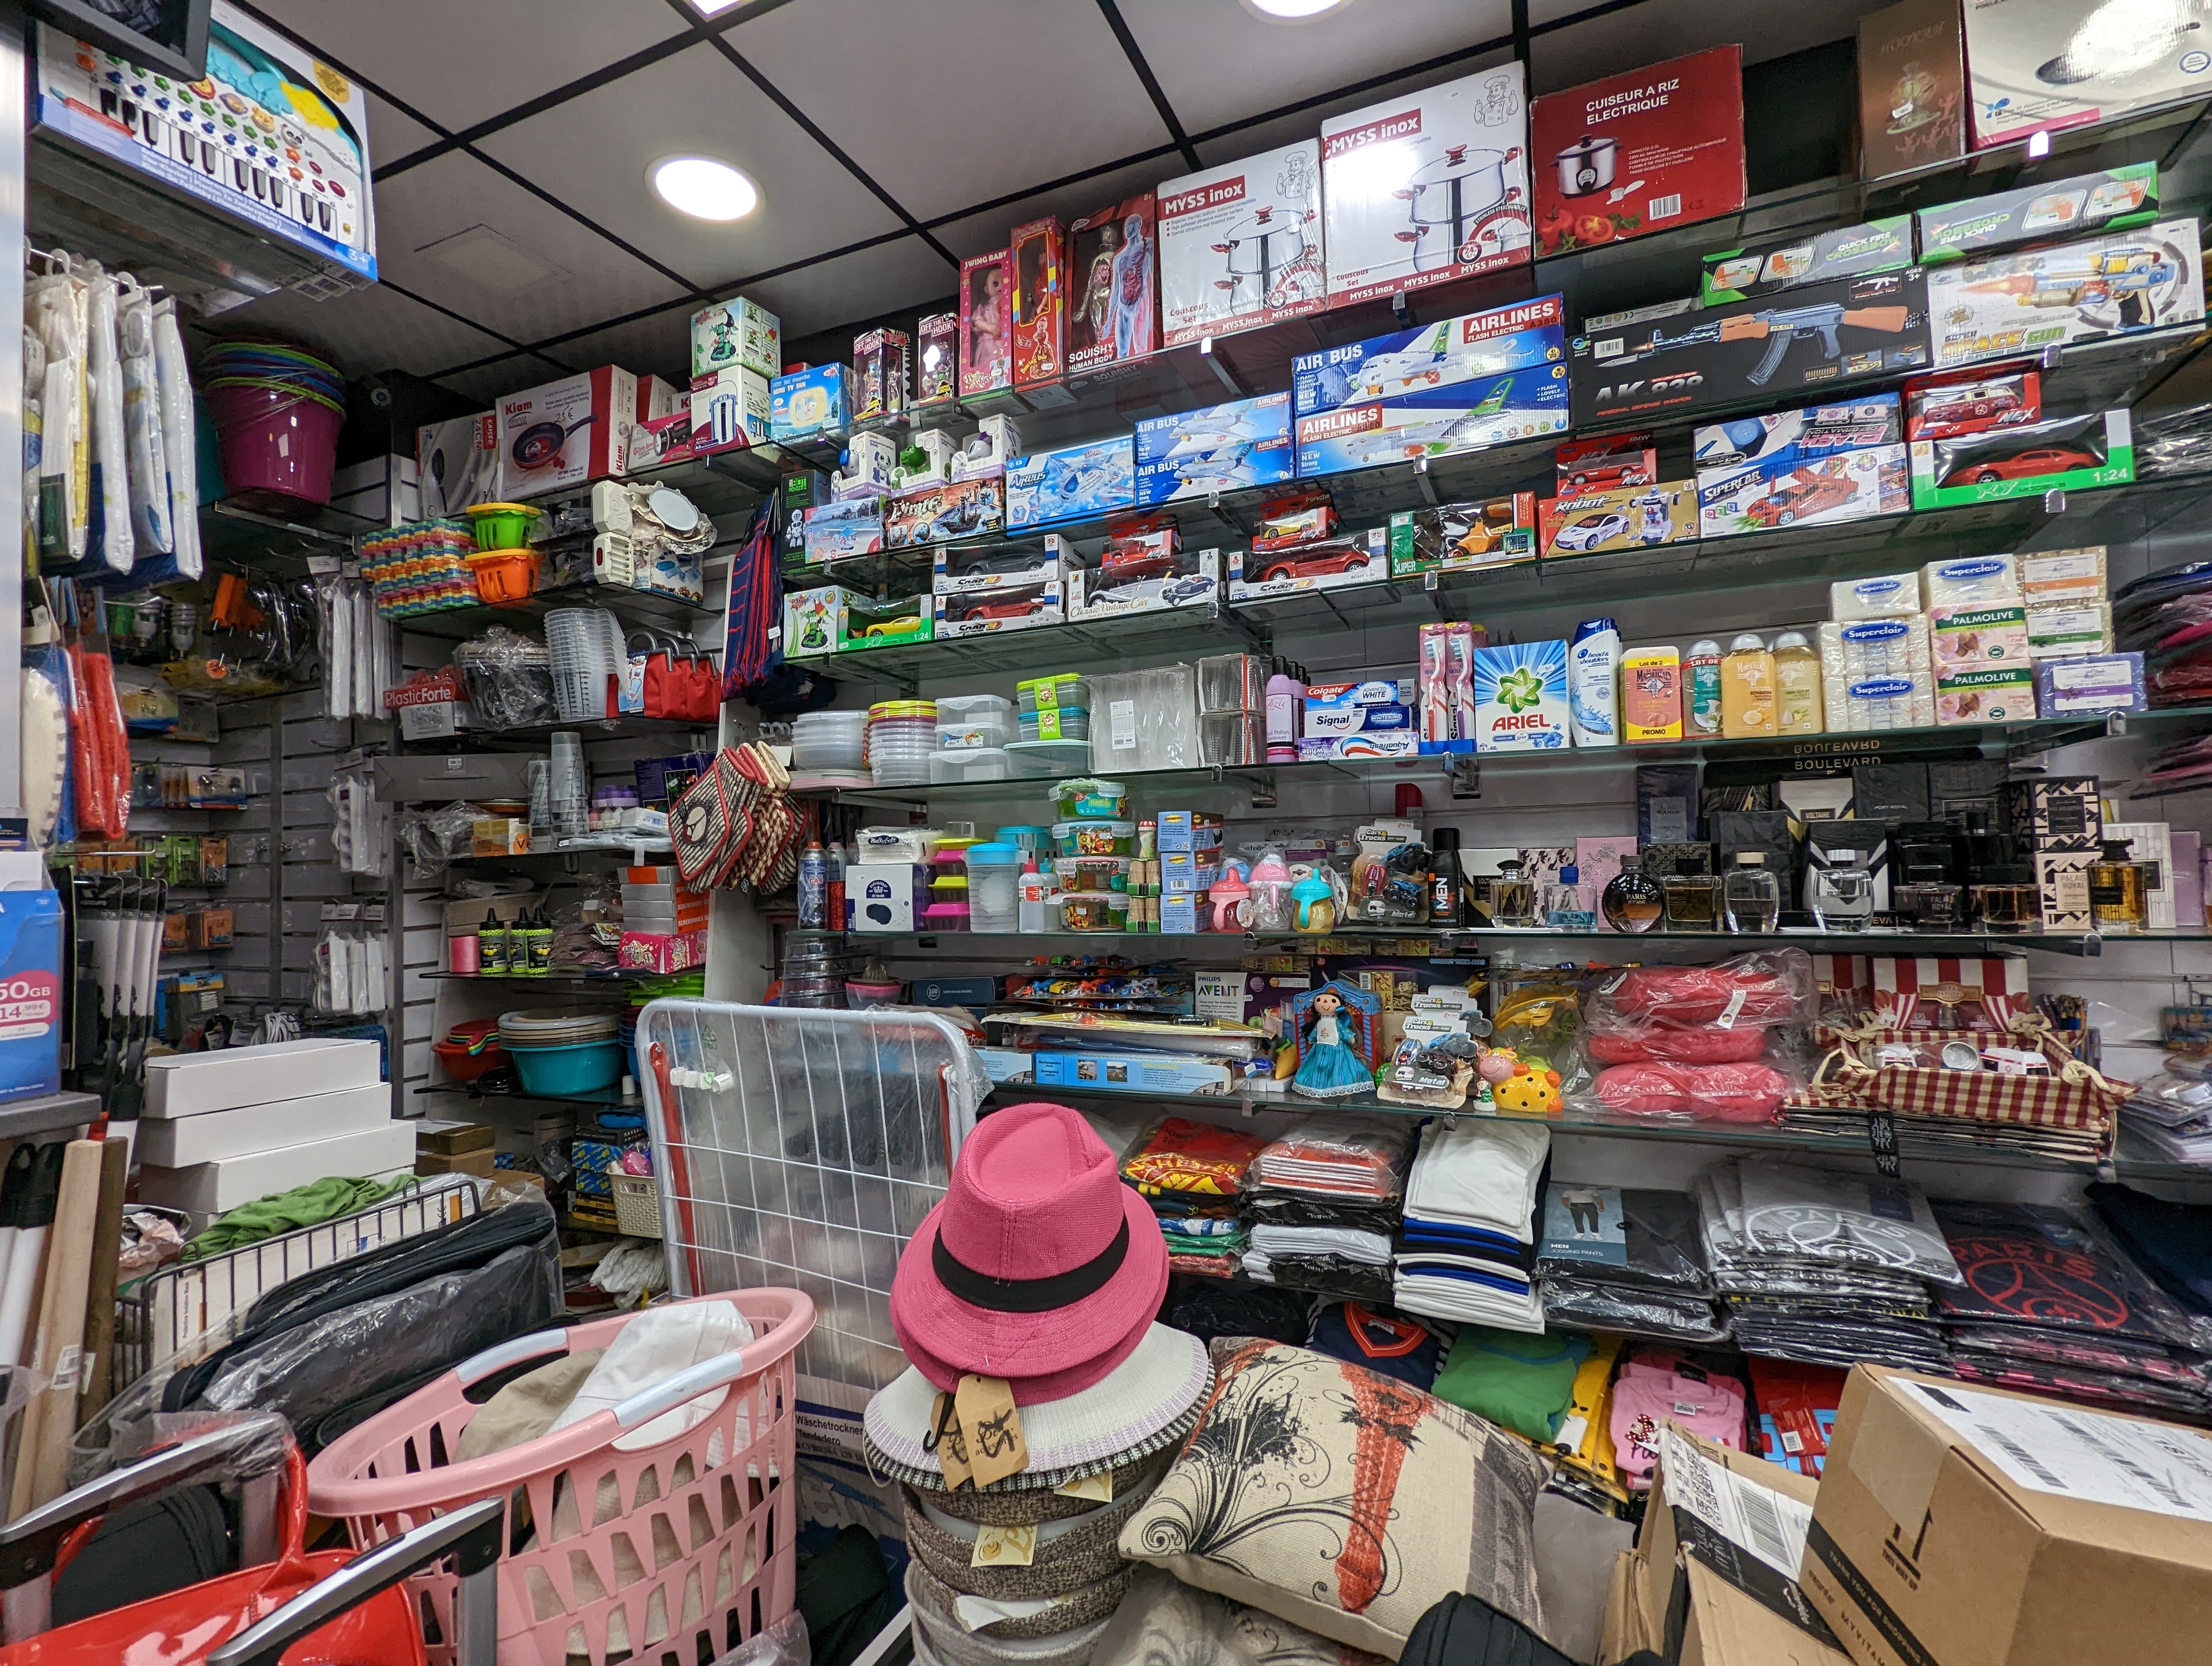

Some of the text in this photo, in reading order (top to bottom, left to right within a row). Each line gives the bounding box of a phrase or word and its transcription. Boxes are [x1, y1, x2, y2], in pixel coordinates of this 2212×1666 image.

[1586, 79, 1680, 112] CUISEUR A RIZ
[1587, 95, 1669, 125] ELECTRIQUE
[1332, 117, 1419, 153] MYSS inox
[1165, 183, 1243, 215] MYSS inox
[1837, 230, 1892, 252] QUICK FIRE
[1939, 223, 1997, 245] QUICK FIRE
[1825, 234, 1900, 261] CROSSBOW
[349, 248, 368, 264] 3+
[964, 251, 1007, 268] SWING BABY
[1461, 257, 1509, 274] MYSS inox
[1905, 267, 1922, 275] AGES
[1336, 268, 1369, 281] Couscous
[1404, 271, 1451, 288] MYSS inox
[1908, 273, 1921, 282] 3+
[1347, 279, 1359, 287] Set
[1349, 284, 1394, 300] MYSS inox
[1170, 303, 1209, 317] Couscous
[1271, 304, 1314, 319] MYSS inox
[933, 318, 942, 326] THE
[1182, 316, 1197, 325] Set
[1223, 316, 1263, 331] MYSS inox
[1468, 302, 1555, 334] AIRLINES
[921, 322, 933, 333] OFF
[933, 323, 953, 335] HOOK
[1197, 328, 1214, 336] inox
[1468, 324, 1525, 342] FLASH ELECTRIC
[2027, 326, 2067, 345] GUN
[854, 341, 865, 352] OFF
[865, 339, 882, 354] HOOK
[1069, 342, 1114, 364] SQUISHY
[1069, 354, 1114, 372] HUMAN BODY
[1296, 343, 1363, 372] AIR BUS
[787, 385, 795, 393] TV
[1298, 391, 1317, 400] NEW
[1541, 388, 1561, 396] LOVELY
[1257, 394, 1288, 407] AIRLINES
[1541, 392, 1566, 402] ELECTRIC
[505, 401, 532, 415] Kiam
[1597, 395, 1692, 416] PERSONAL DEFENSE WEAPON
[554, 405, 574, 424] 25€
[1303, 408, 1379, 435] AIRLINES
[1997, 406, 2037, 424] NEX
[1137, 416, 1179, 433] AIR BUS
[1257, 436, 1289, 448] AIRLINES
[1303, 428, 1353, 444] FLASH ELECTRIC
[1629, 434, 1651, 443] BMW
[1301, 452, 1321, 462] NEW
[1138, 459, 1179, 477] AIR BUS
[2093, 467, 2128, 482] 1:24
[1622, 471, 1652, 485] NEX
[1705, 470, 1762, 502] SUPERCAR
[1305, 494, 1330, 503] Porsche
[1552, 494, 1611, 516] Robot
[1300, 527, 1322, 539] NEX
[1146, 547, 1167, 559] NEX
[1394, 558, 1417, 575] SUPER
[1944, 563, 2001, 577] Superclair
[1858, 581, 1898, 593] Superclair
[1070, 597, 1149, 618] Classic Vintage Car
[1953, 610, 2015, 625] PALMOLIVE
[1849, 626, 1904, 639] Superclair
[1966, 623, 2002, 631] NATURALS
[913, 632, 929, 642] 1:24
[1579, 657, 1610, 665] shoulders
[1954, 672, 2017, 685] PALMOLIVE
[384, 686, 452, 704] PlasticForte
[1308, 685, 1345, 697] Colgate
[1362, 685, 1387, 694] ADVANCED
[1362, 690, 1387, 700] WHITE
[1855, 683, 1908, 695] Superclair
[1316, 715, 1350, 727] Signal
[1371, 714, 1403, 722] WHITENING
[1491, 714, 1551, 732] ARIEL
[1369, 741, 1410, 751] Aquafresh
[1795, 756, 1881, 771] BOULEVARD
[1358, 833, 1386, 842] Trucks
[2060, 874, 2087, 882] PALAIS
[2062, 881, 2086, 889] ROYAL
[1435, 877, 1448, 909] MEN
[1198, 985, 1239, 997] AVENT
[1415, 1001, 1442, 1009] Trucks
[1406, 1023, 1432, 1031] Trucks
[1778, 1208, 1912, 1240] PARIS
[1580, 1249, 1604, 1257] PANTS
[1952, 1241, 2097, 1279] PARIS
[795, 1415, 863, 1435] Wäschetrockner
[798, 1428, 841, 1446] Tendedero
